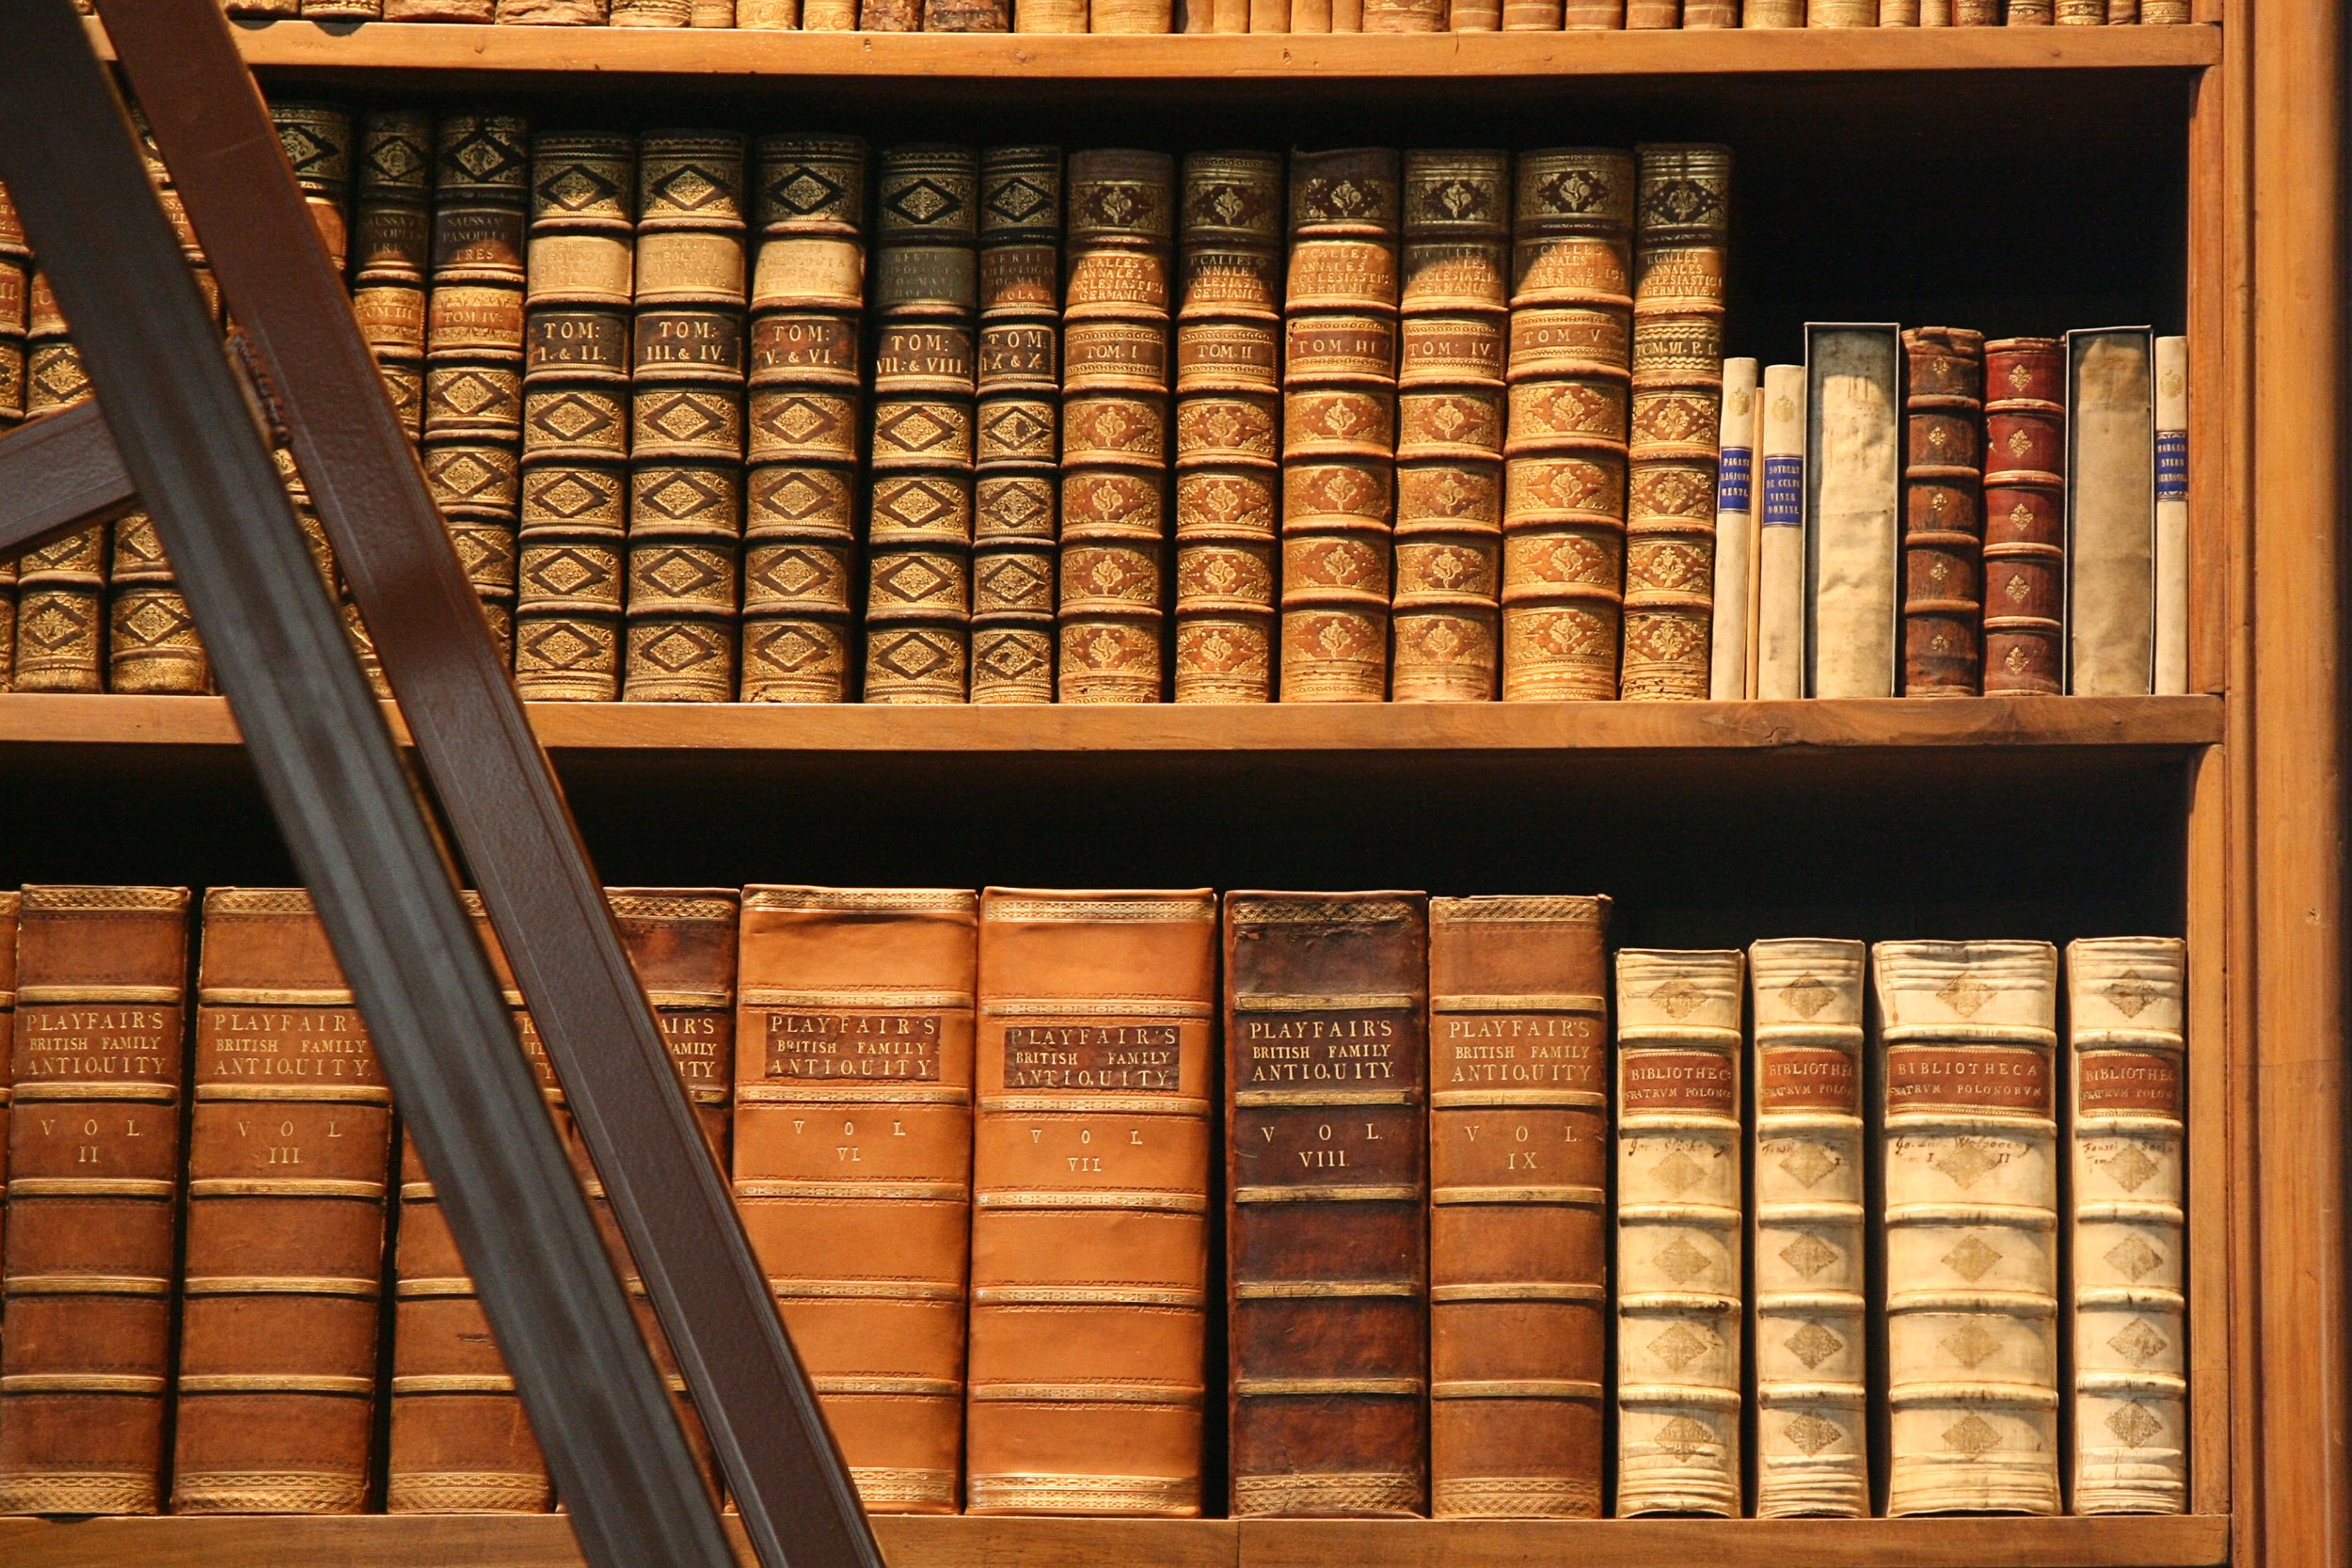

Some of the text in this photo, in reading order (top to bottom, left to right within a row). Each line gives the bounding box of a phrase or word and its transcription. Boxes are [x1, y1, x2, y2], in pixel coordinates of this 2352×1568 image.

[454, 247, 495, 261] TRES
[1081, 267, 1143, 279] ANNALES
[559, 347, 572, 361] &
[678, 347, 691, 360] &
[788, 351, 800, 363] &
[909, 359, 920, 372] &
[1009, 355, 1022, 368] &
[25, 1011, 164, 1032] PLAYFAIR'S
[214, 1013, 369, 1033] PLAYFAIR'
[771, 1016, 934, 1036] PLAYFAIR'S
[1449, 1020, 1590, 1038] PLAYFAIR'S
[1010, 1028, 1176, 1046] PLAYFAIR'S
[1249, 1020, 1392, 1039] PLAYFAIR'S
[29, 1036, 162, 1051] BRITISH FAMILY
[215, 1038, 367, 1053] BRITISH FAMILY
[671, 1041, 718, 1056] AMILY
[777, 1039, 927, 1055] BRITISH FAMILY
[1252, 1043, 1392, 1059] BRITISH FAMILY
[1016, 1051, 1170, 1066] BRITISH FAMILY
[1454, 1045, 1591, 1060] BRITISH FAMILY
[1898, 1061, 2038, 1078] BIBLIOTHECA
